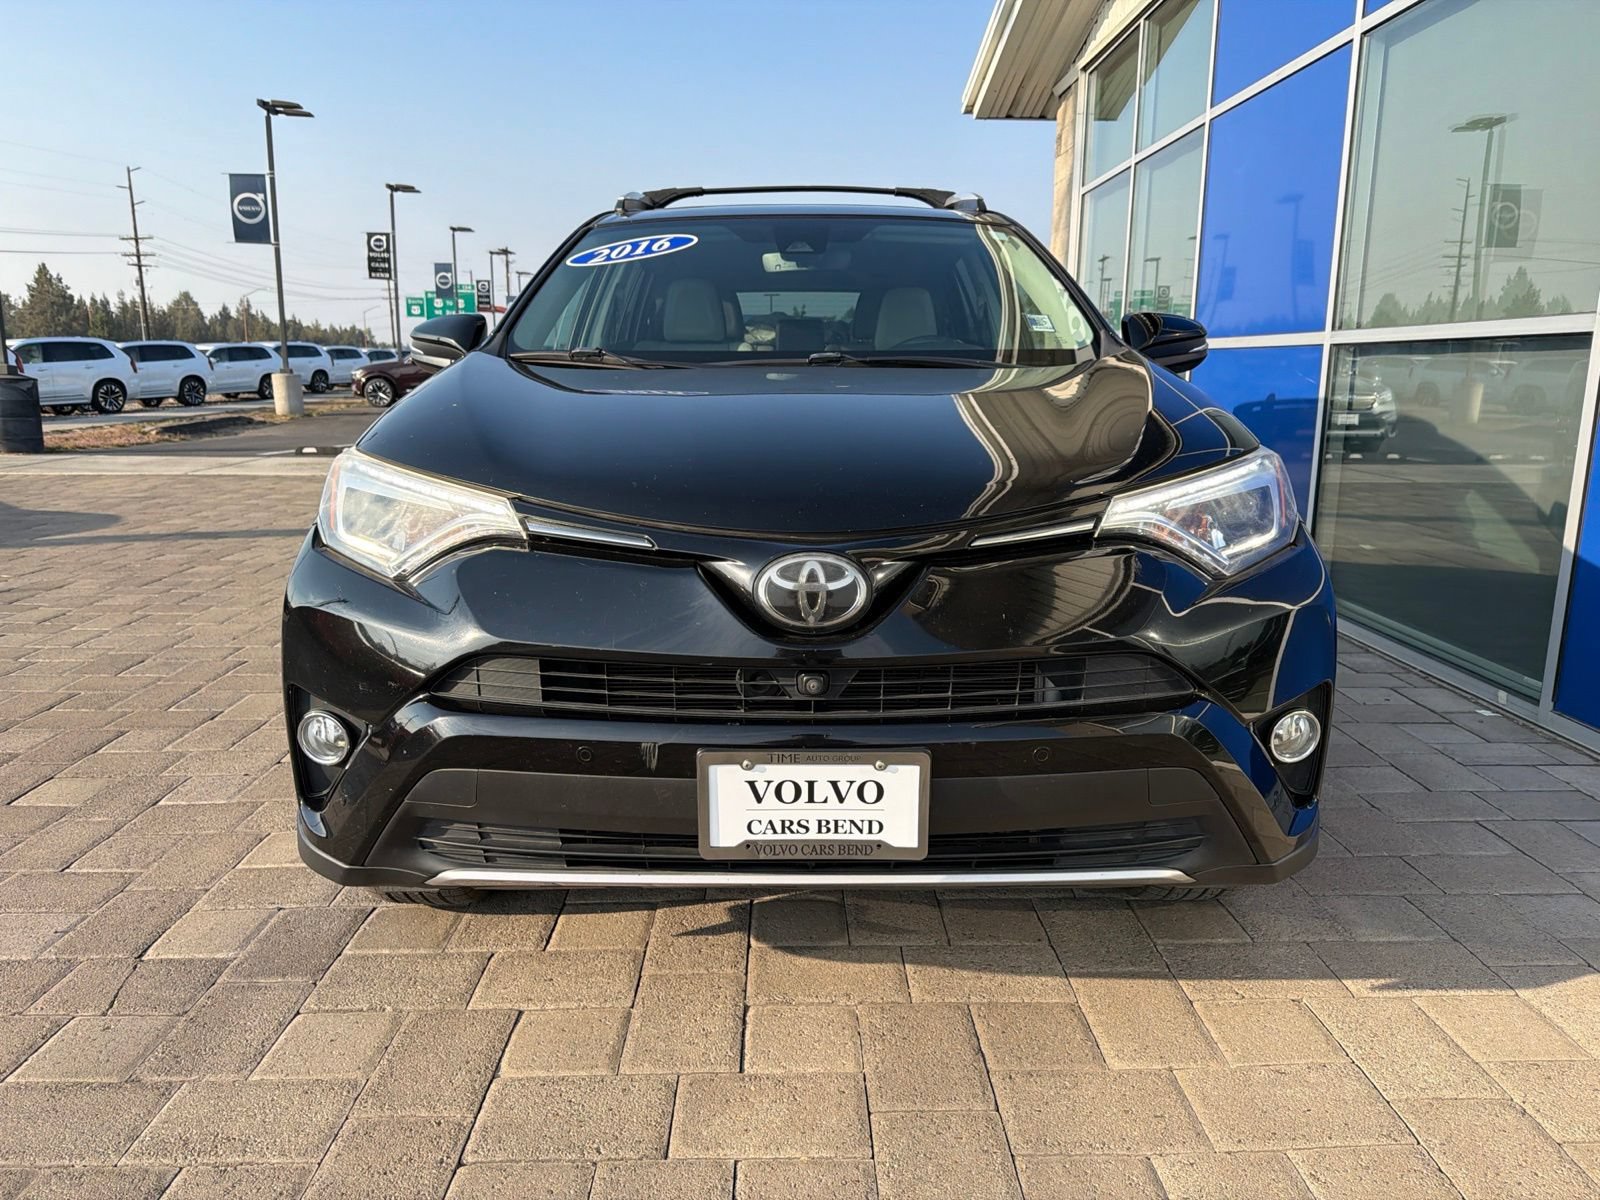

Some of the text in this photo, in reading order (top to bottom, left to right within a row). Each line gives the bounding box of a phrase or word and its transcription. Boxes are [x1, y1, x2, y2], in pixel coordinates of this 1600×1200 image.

[587, 236, 674, 265] 2016
[768, 753, 800, 764] TIME
[744, 779, 885, 805] VOLVO
[746, 819, 884, 835] CARS BEND
[753, 844, 873, 856] VOLVO CARS BEND
